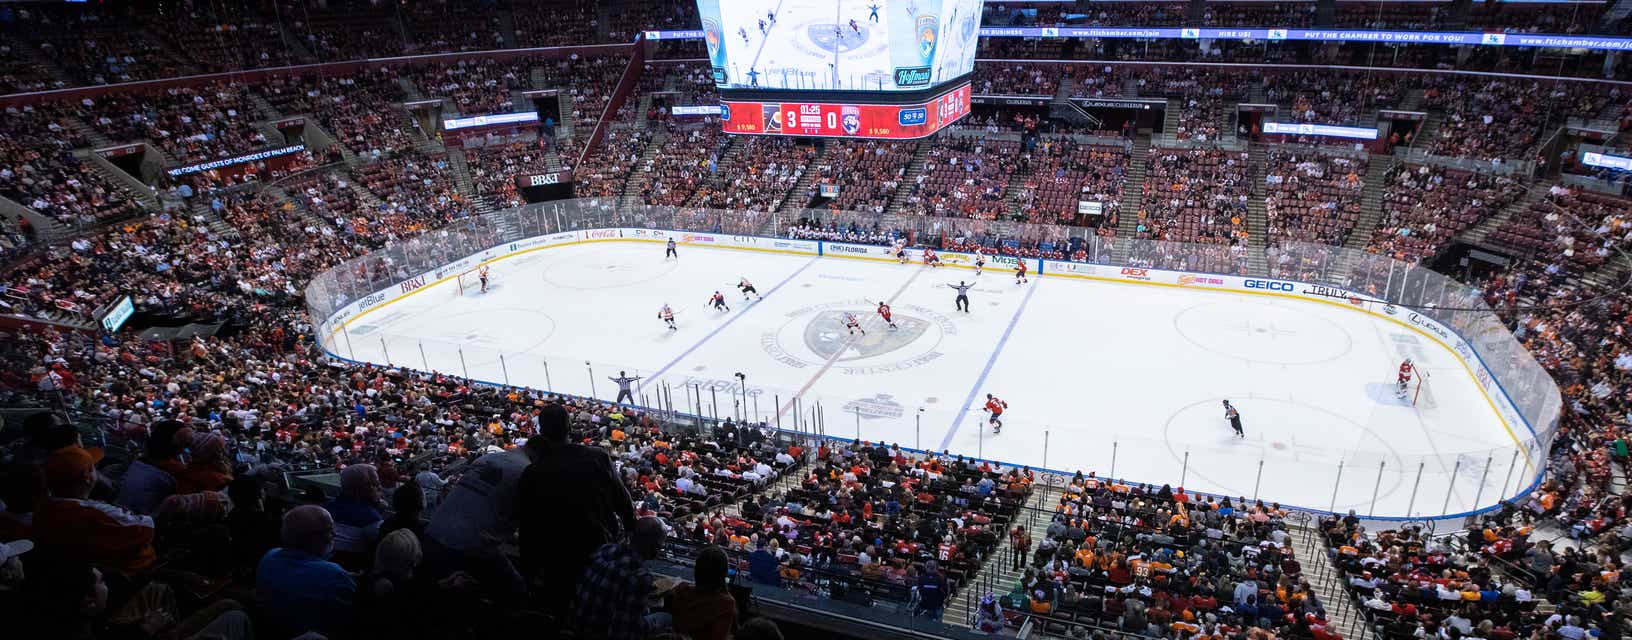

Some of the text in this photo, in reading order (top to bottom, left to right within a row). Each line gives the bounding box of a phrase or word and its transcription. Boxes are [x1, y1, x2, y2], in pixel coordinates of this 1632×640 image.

[800, 104, 821, 115] 01:25
[787, 111, 797, 128] 3
[827, 112, 837, 129] 0
[167, 164, 201, 176] WELCOME
[200, 160, 225, 170] GUESTS
[263, 151, 271, 159] OF
[271, 148, 287, 157] PALM
[286, 145, 305, 154] BEACH
[530, 172, 561, 186] BB&T
[845, 246, 868, 254] FLORIDA
[1120, 268, 1149, 277] DEX
[400, 275, 427, 294] BB&T
[1244, 279, 1295, 292] GEICO
[1311, 284, 1348, 298] TRULY
[358, 292, 386, 312] jetBlue
[1420, 319, 1448, 339] LEXUS
[1136, 566, 1149, 577] 93
